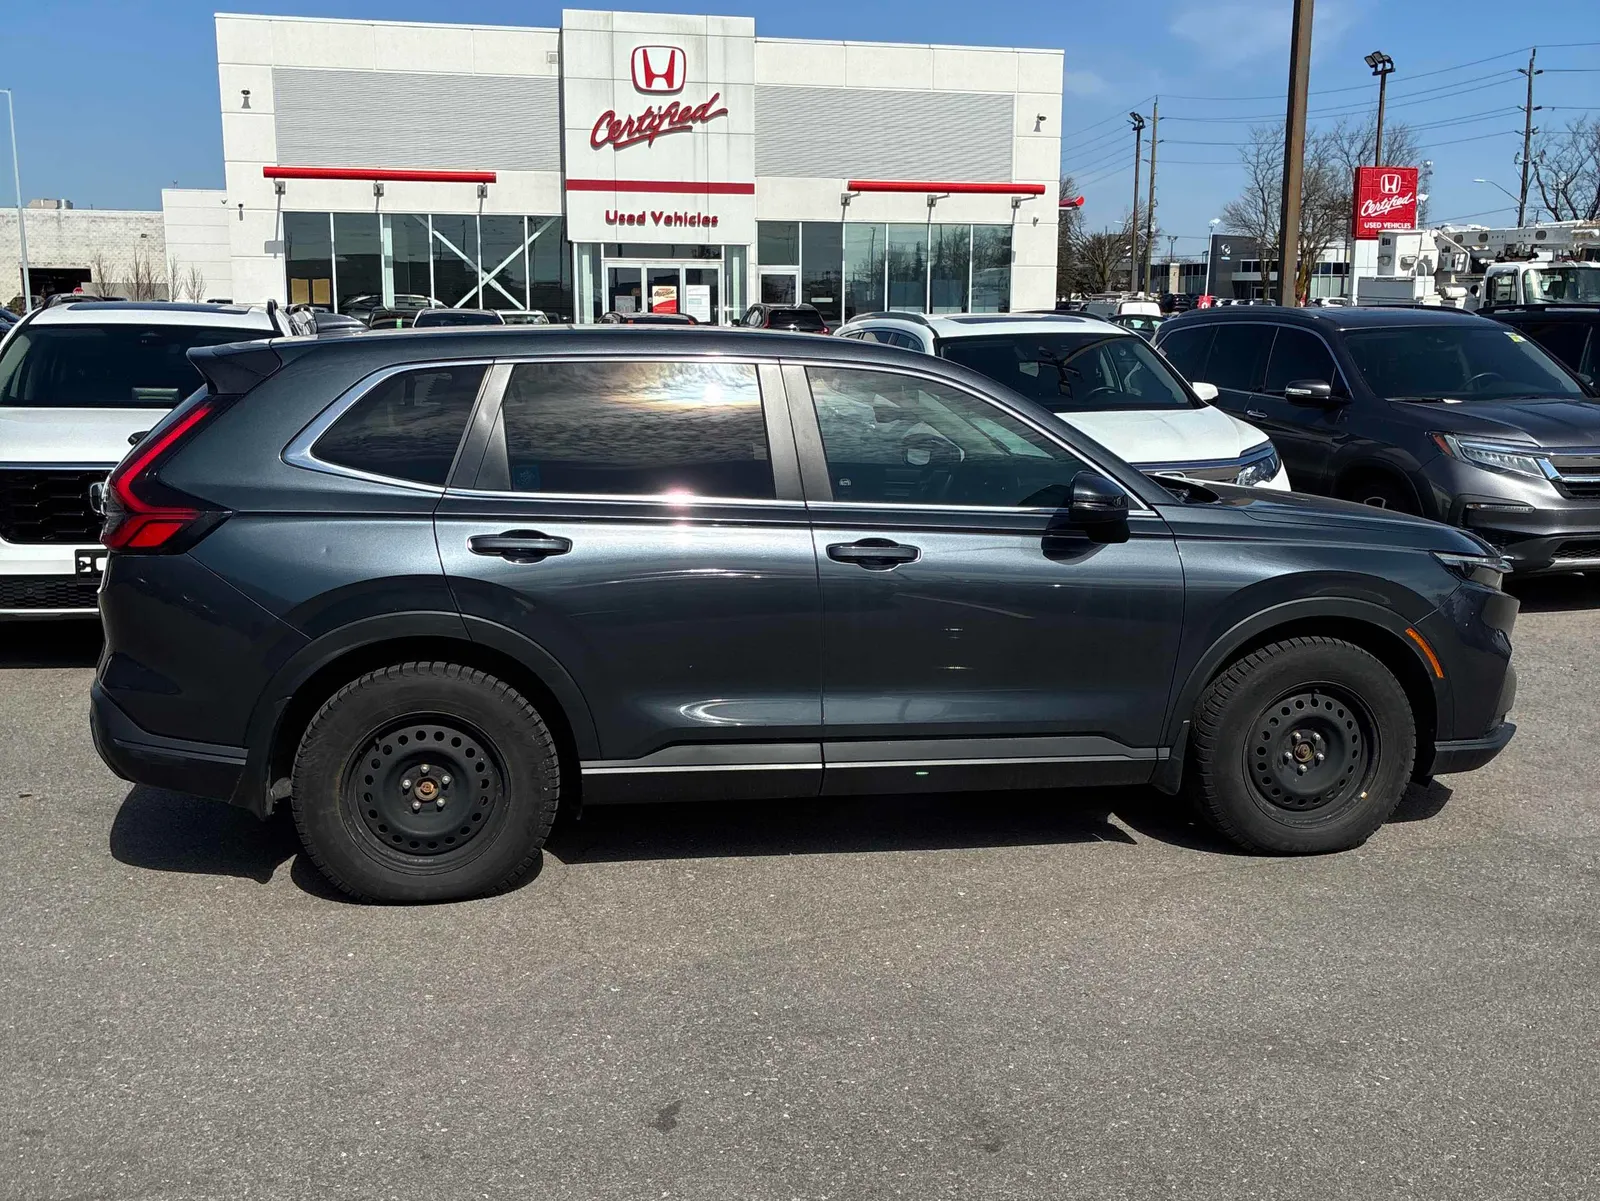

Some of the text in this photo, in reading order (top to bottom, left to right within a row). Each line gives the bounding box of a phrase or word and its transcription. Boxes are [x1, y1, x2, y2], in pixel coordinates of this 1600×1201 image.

[590, 92, 728, 150] Certified
[1361, 192, 1414, 217] Certified
[605, 209, 719, 228] Used Vehicles
